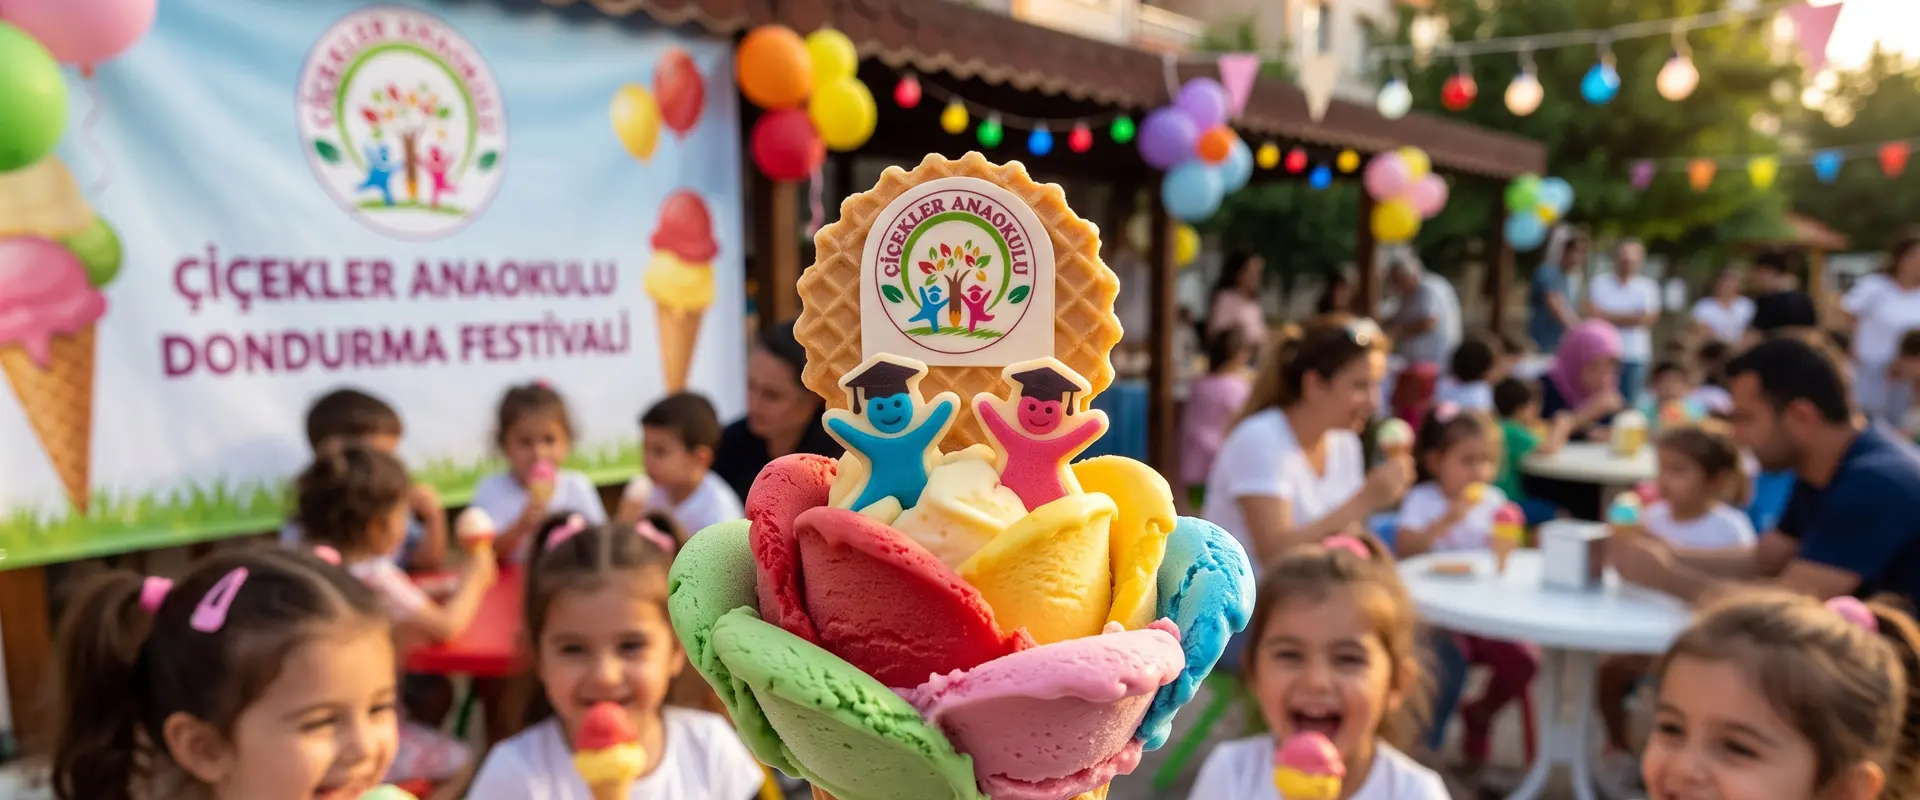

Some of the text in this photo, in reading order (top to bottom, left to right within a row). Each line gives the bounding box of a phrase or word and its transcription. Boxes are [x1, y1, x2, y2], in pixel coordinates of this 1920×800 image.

[880, 196, 1028, 278] ÇİÇEKLER ANAOKULU
[173, 245, 617, 313] ÇİÇEKLER ANAOKULU
[162, 307, 631, 377] DONDURMA FESTİVALİ
